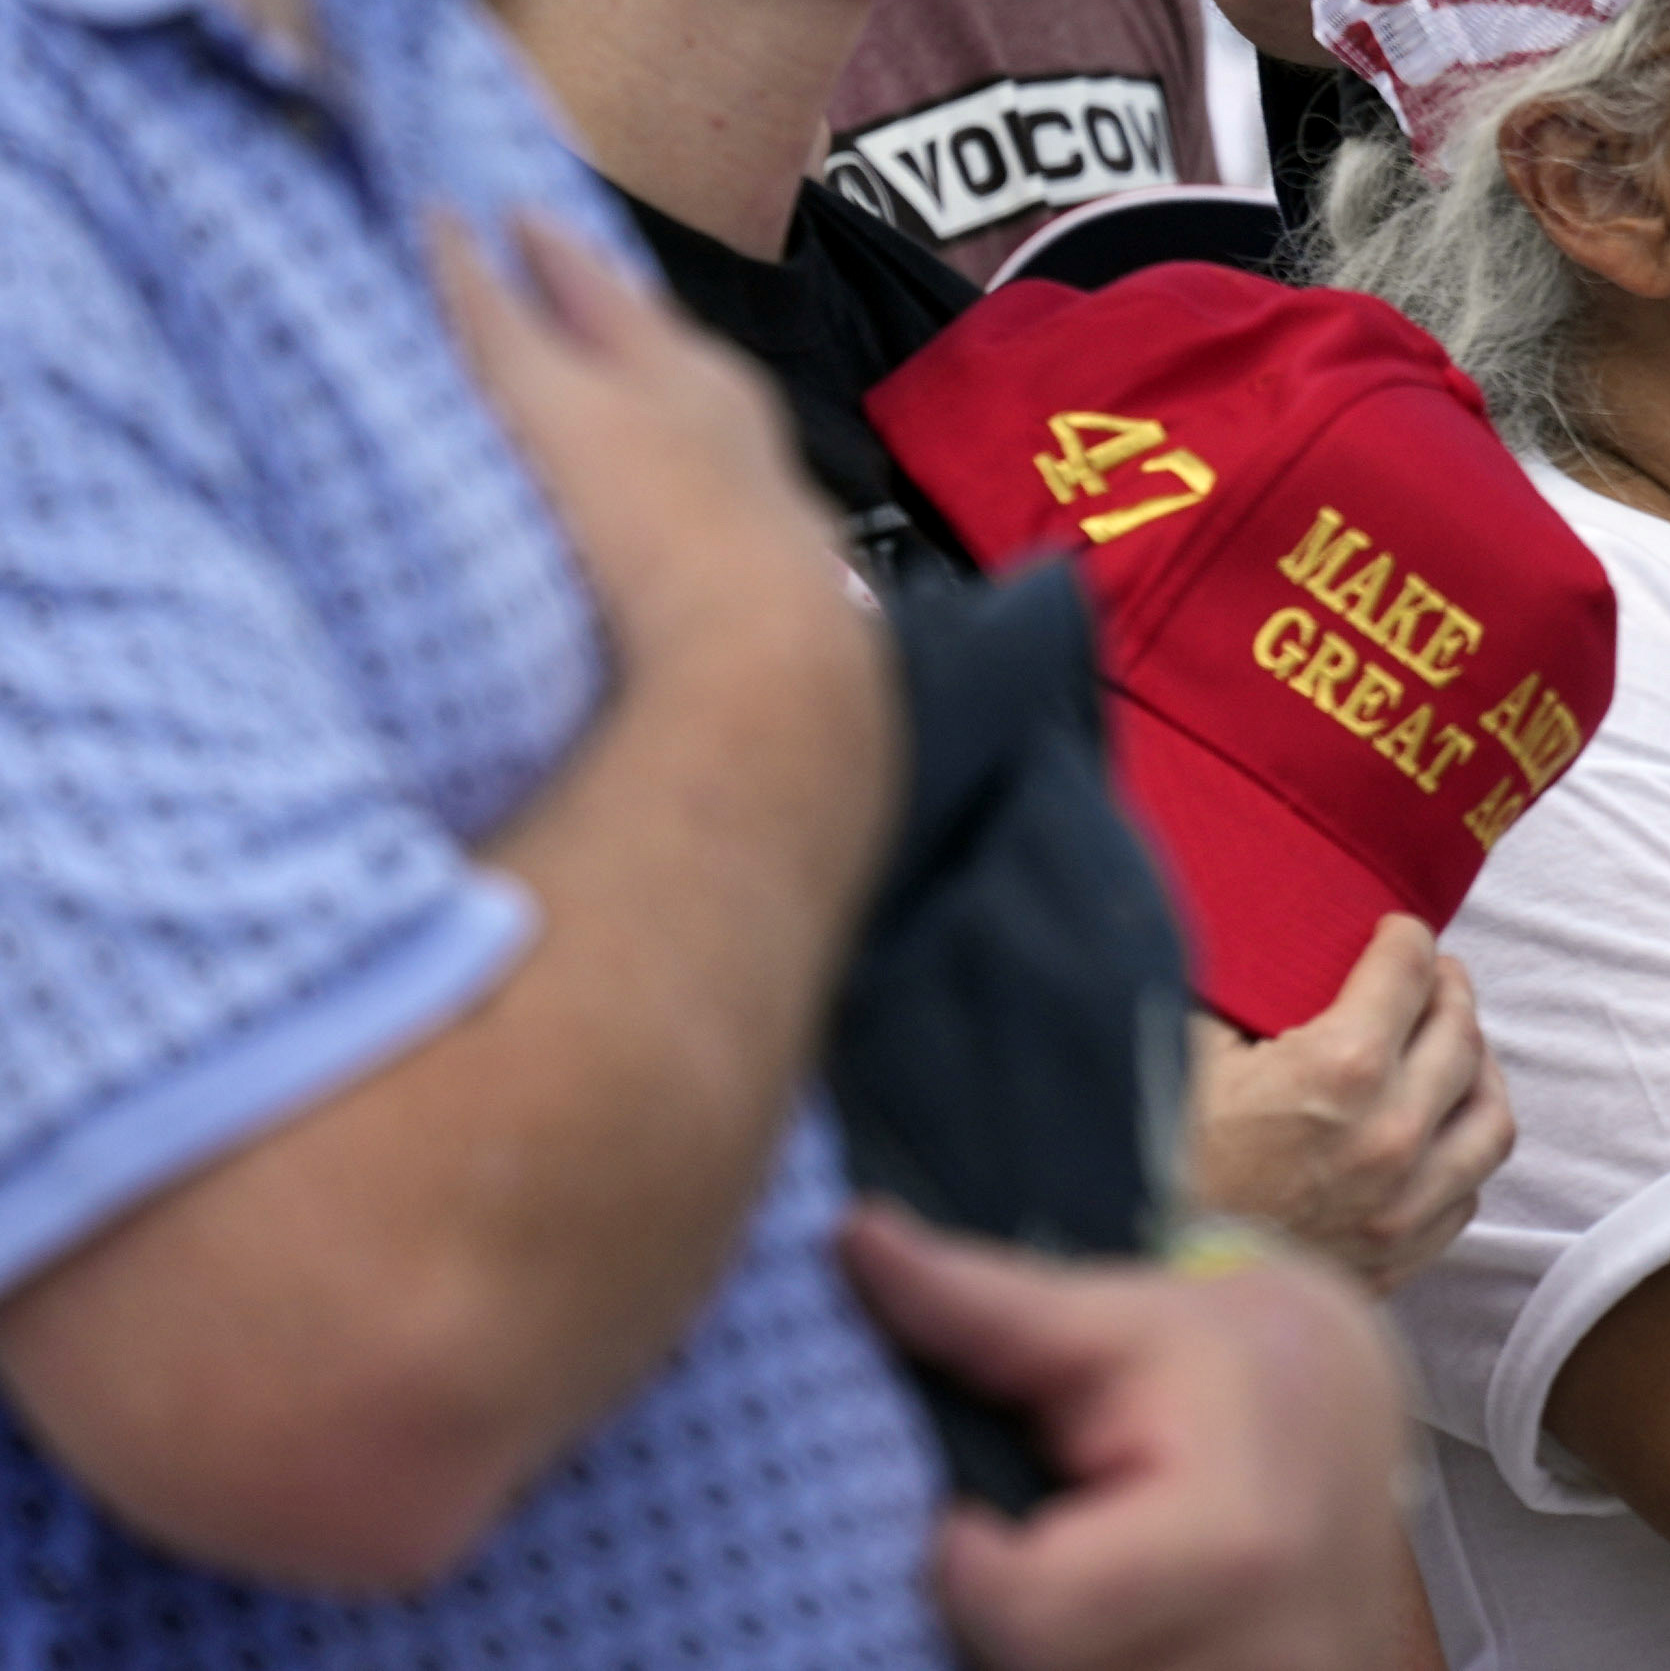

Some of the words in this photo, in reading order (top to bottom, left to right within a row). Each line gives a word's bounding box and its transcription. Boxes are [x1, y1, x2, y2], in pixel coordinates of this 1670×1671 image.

[1033, 410, 1217, 545] 47
[1276, 505, 1484, 689] MAKE
[1252, 607, 1478, 795] GREAT
